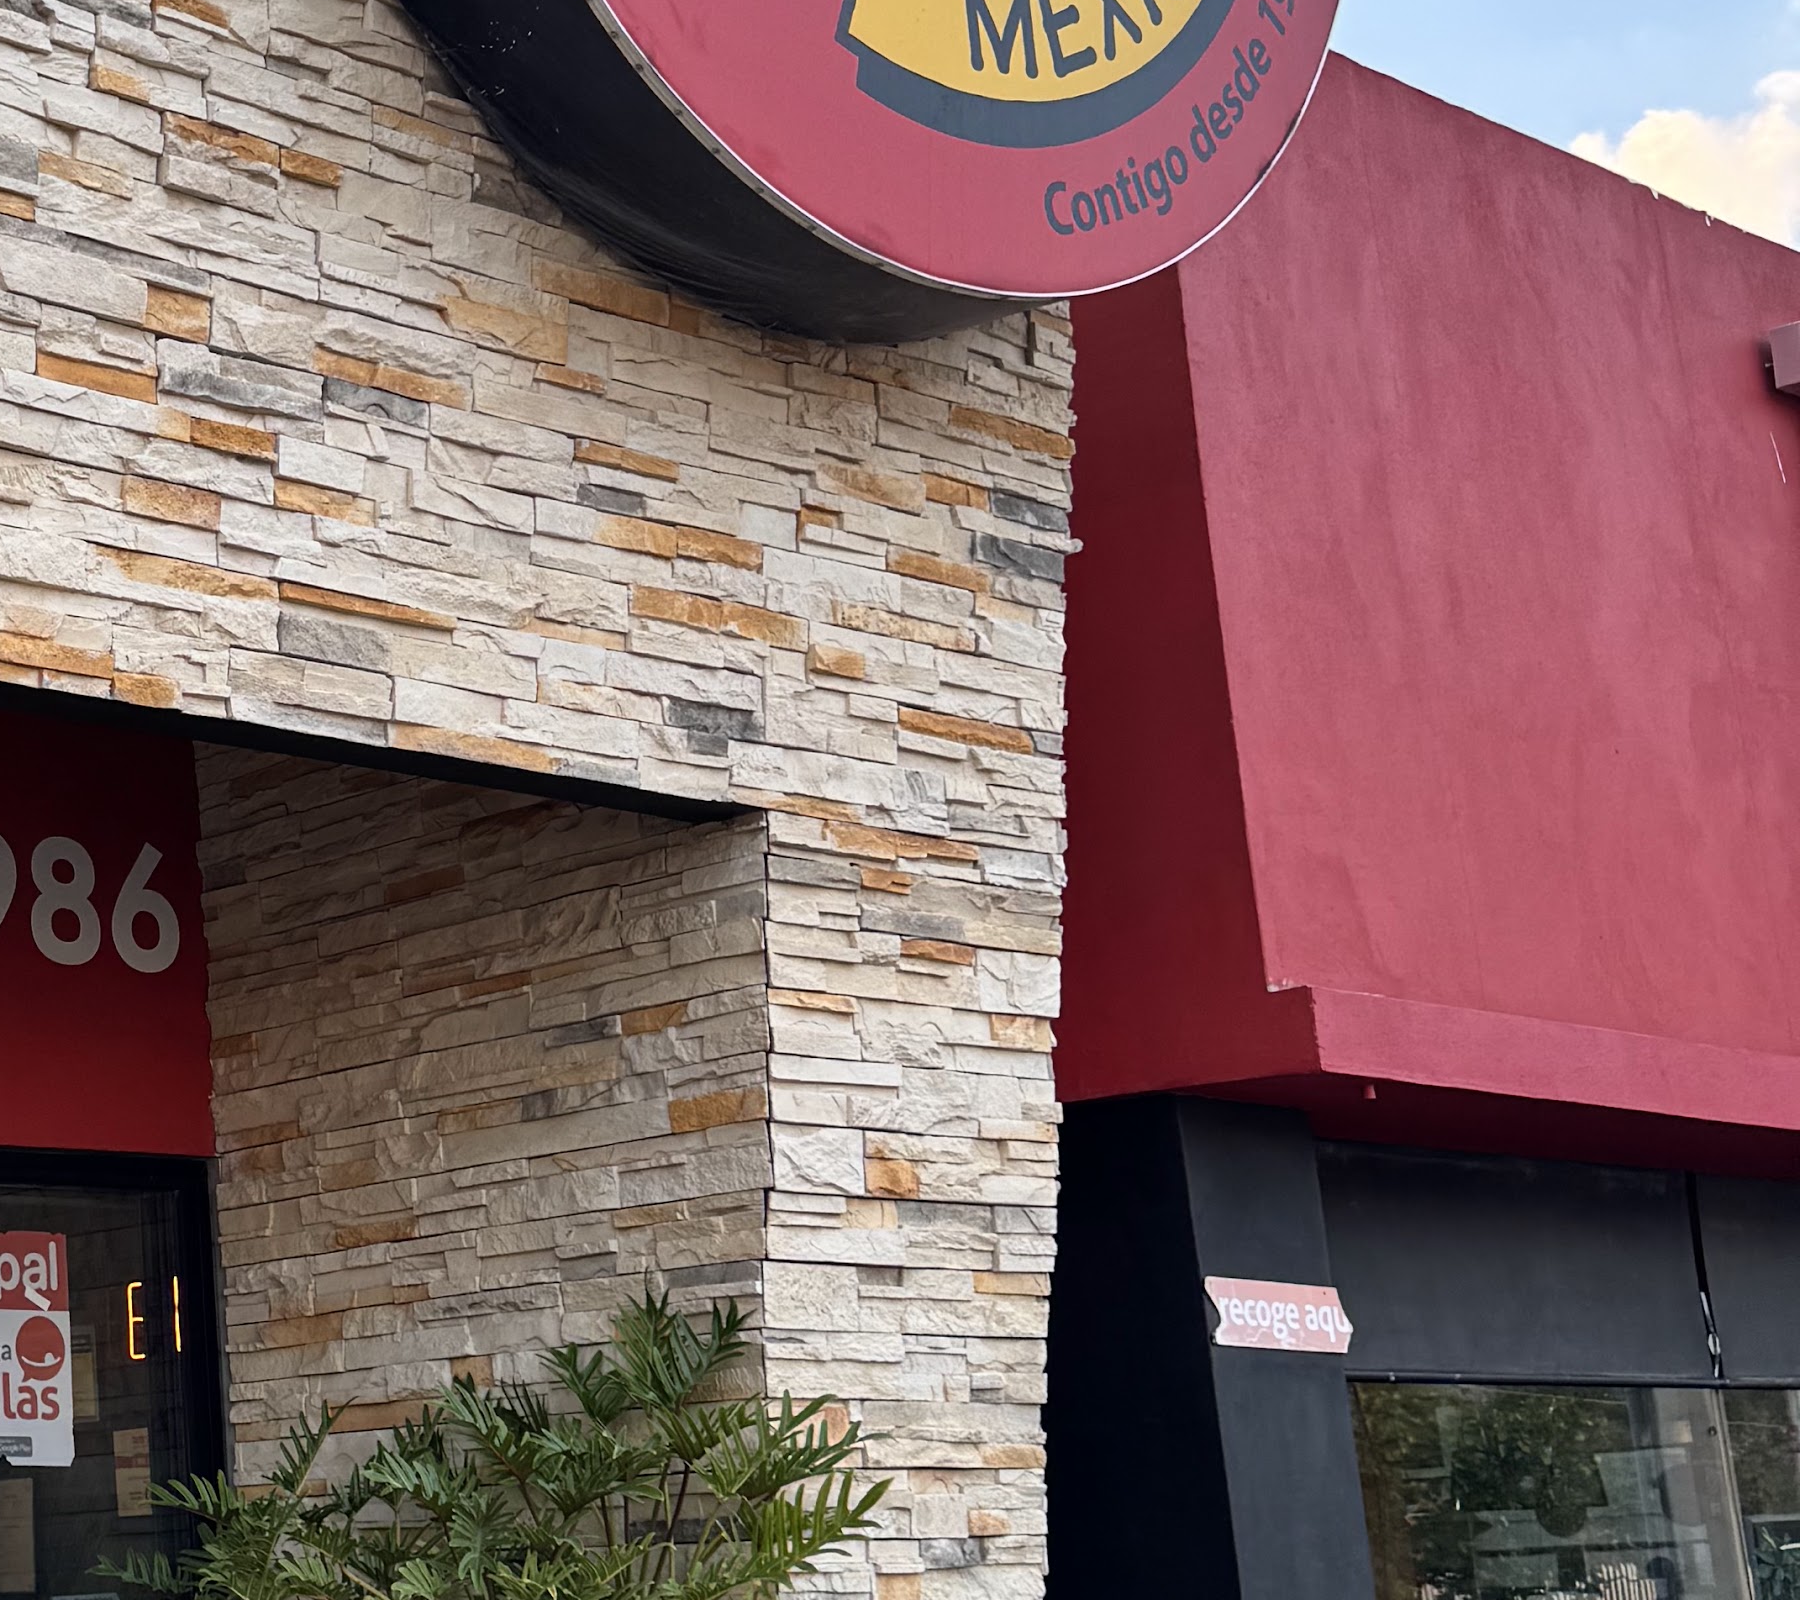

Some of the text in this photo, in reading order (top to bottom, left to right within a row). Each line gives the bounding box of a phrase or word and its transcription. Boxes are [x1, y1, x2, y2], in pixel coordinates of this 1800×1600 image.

[1044, 145, 1189, 235] Contigo
[1189, 37, 1272, 163] desde
[1217, 1296, 1300, 1340] recoge
